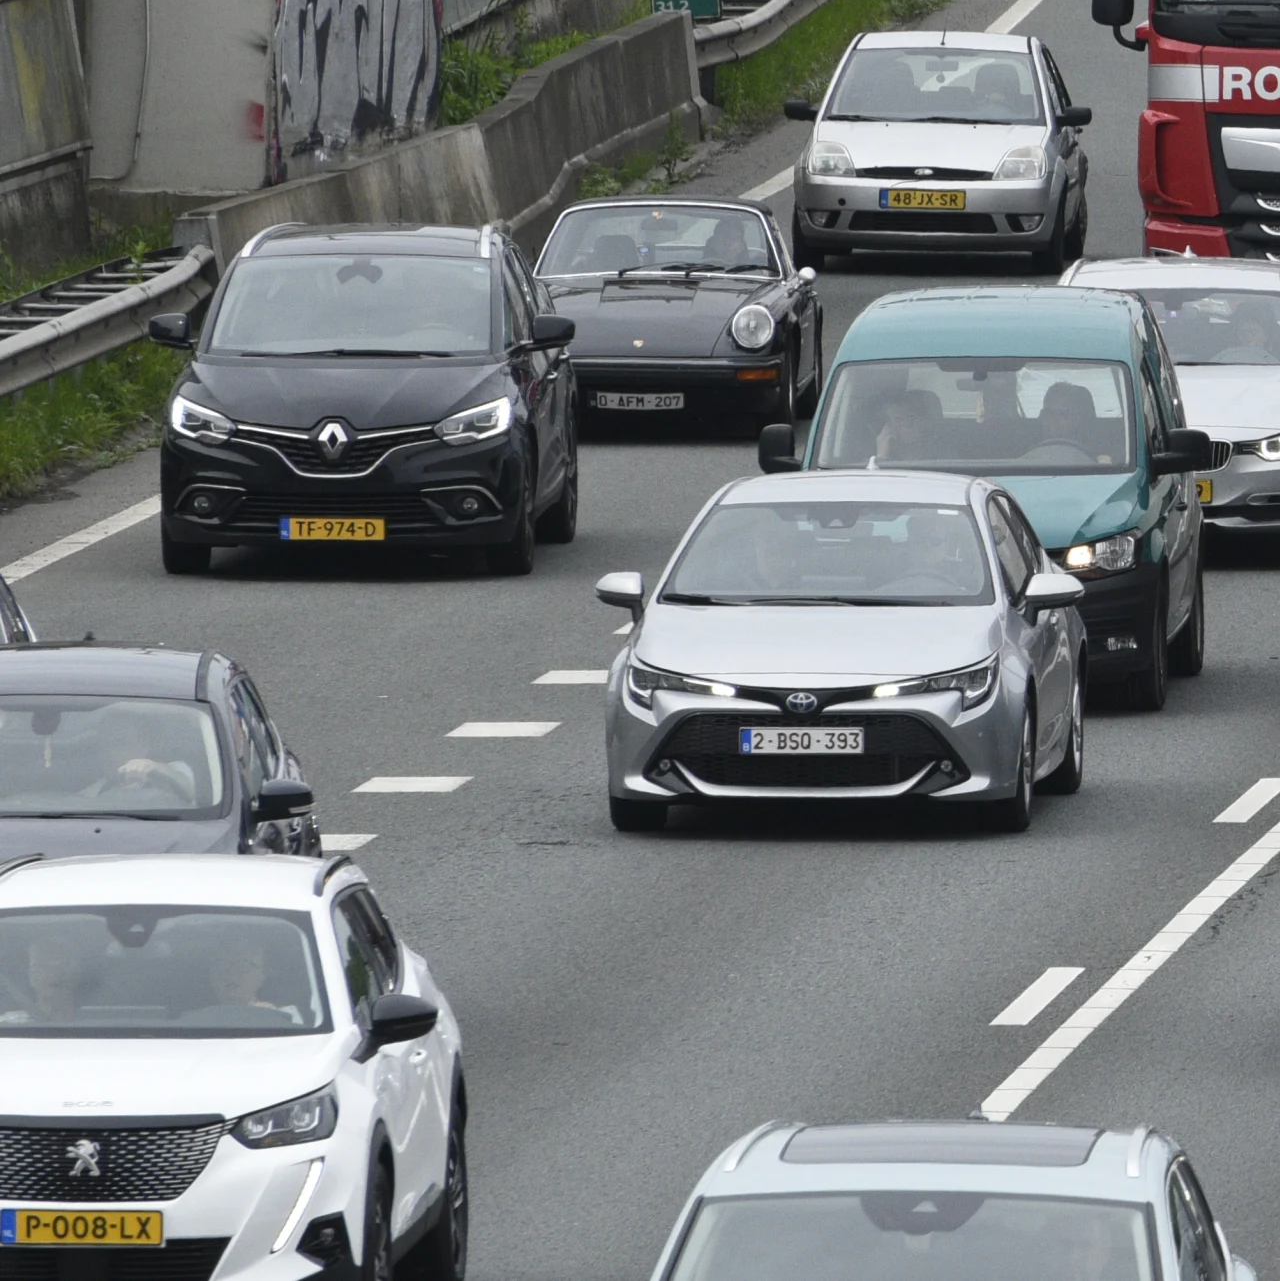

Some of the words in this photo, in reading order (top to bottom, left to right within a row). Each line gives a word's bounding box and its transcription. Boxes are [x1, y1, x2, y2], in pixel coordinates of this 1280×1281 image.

[295, 520, 377, 539] TF-974-D
[753, 731, 861, 752] 2-BSQ-393
[25, 1214, 152, 1241] P-008-LX
